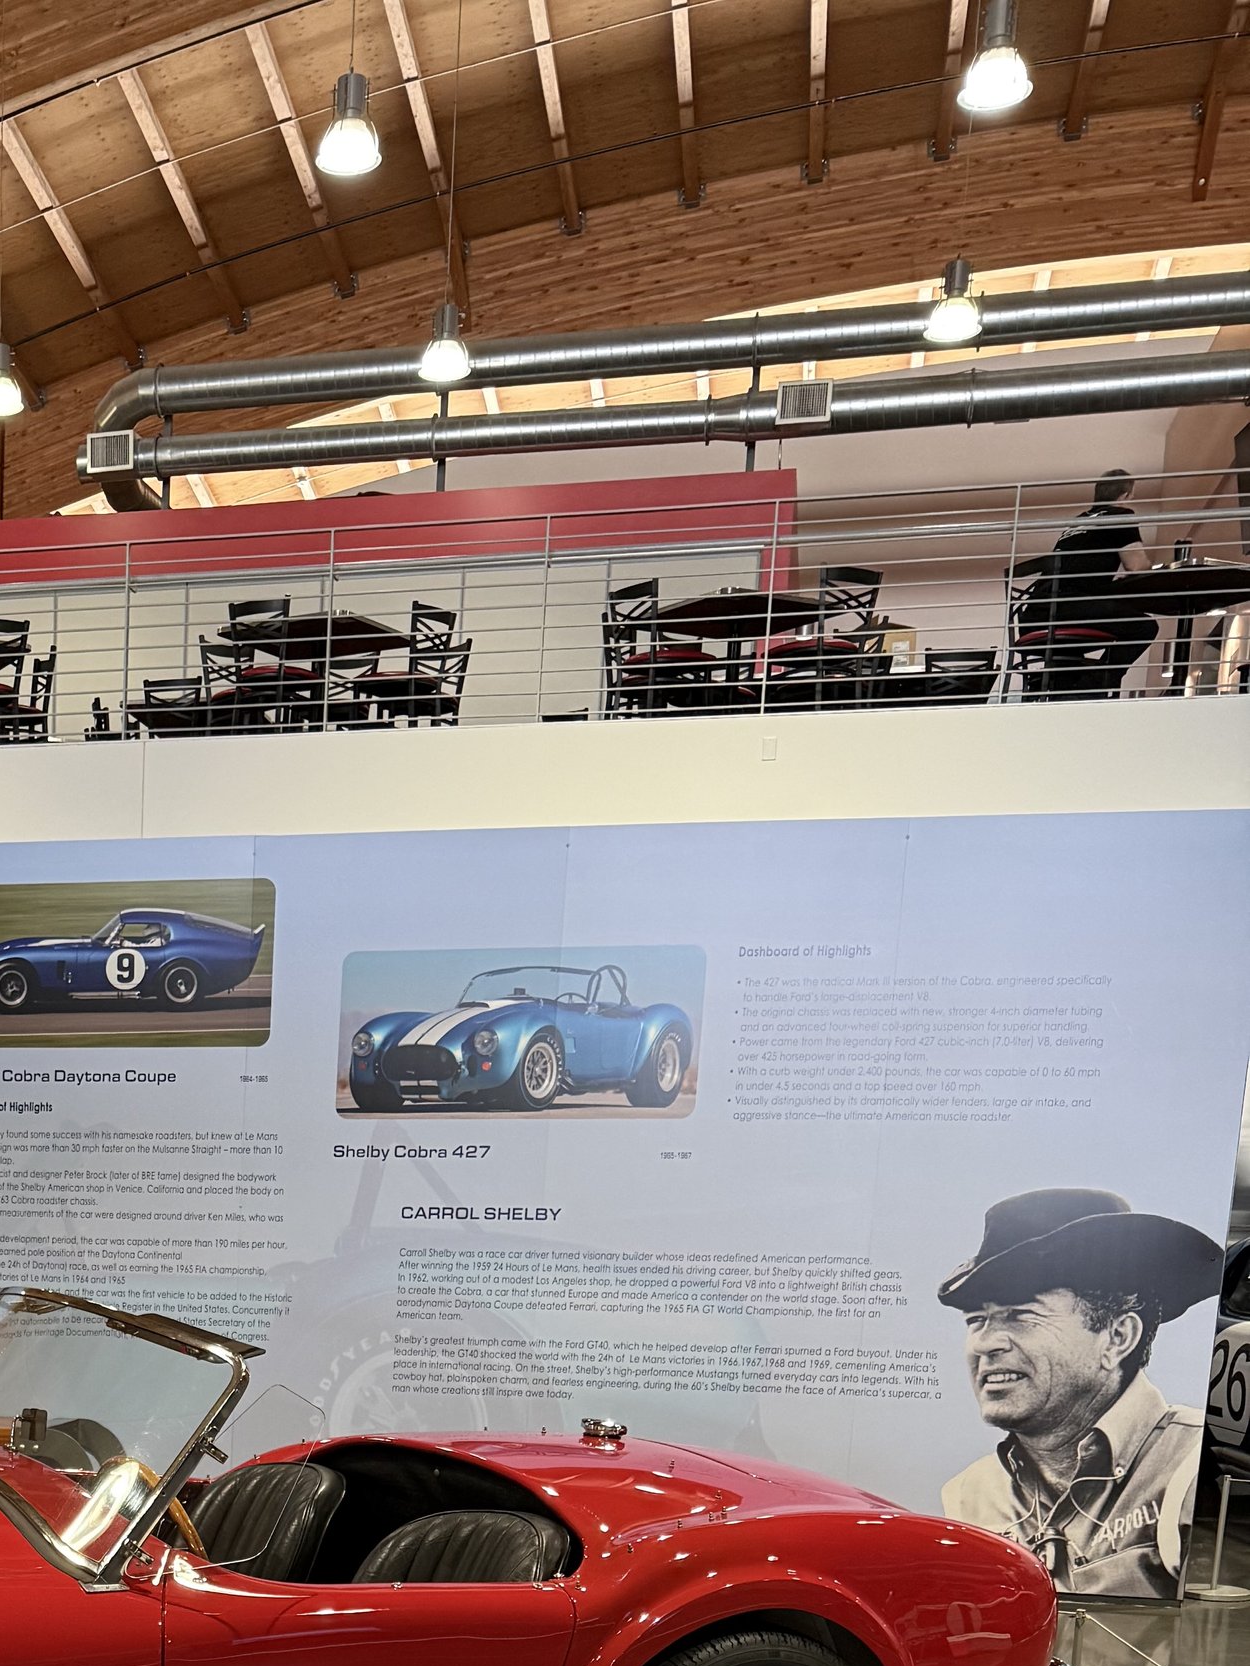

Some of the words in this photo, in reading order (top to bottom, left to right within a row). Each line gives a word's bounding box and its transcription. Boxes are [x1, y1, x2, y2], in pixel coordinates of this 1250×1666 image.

[738, 945, 799, 957] Dashboard
[802, 944, 814, 956] of
[817, 944, 871, 958] Highlights
[117, 953, 135, 983] 9
[2, 1069, 49, 1082] Cobra
[54, 1069, 120, 1085] Daytona
[125, 1069, 176, 1085] Coupe
[9, 1101, 52, 1114] Highlights
[732, 1112, 782, 1122] aggressive
[843, 1110, 882, 1120] ultimate
[884, 1111, 931, 1120] American
[933, 1111, 968, 1121] muscle
[6, 1129, 28, 1138] found
[30, 1131, 50, 1139] some
[52, 1131, 82, 1139] success
[83, 1130, 99, 1139] with
[101, 1130, 111, 1139] his
[112, 1131, 153, 1139] namesake
[195, 1131, 208, 1140] but
[210, 1131, 232, 1140] knew
[233, 1131, 242, 1140] at
[244, 1132, 254, 1140] Le
[256, 1132, 278, 1140] Mans
[333, 1145, 389, 1161] Shelby
[394, 1145, 447, 1158] Cobra
[452, 1145, 490, 1158] 427
[401, 1206, 479, 1219] CARROL
[484, 1207, 561, 1220] SHELBY
[399, 1247, 427, 1257] Carroll
[428, 1247, 456, 1259] Shelby
[458, 1250, 475, 1258] was
[476, 1250, 483, 1258] a
[485, 1250, 505, 1258] race
[524, 1249, 549, 1259] driver
[551, 1250, 580, 1260] turned
[582, 1250, 620, 1261] visionary
[622, 1251, 653, 1261] builder
[655, 1252, 684, 1261] whose
[686, 1252, 711, 1262] ideas
[713, 1252, 758, 1262] redefined
[760, 1253, 805, 1263] American
[808, 1254, 872, 1265] performance.
[396, 1310, 436, 1319] American
